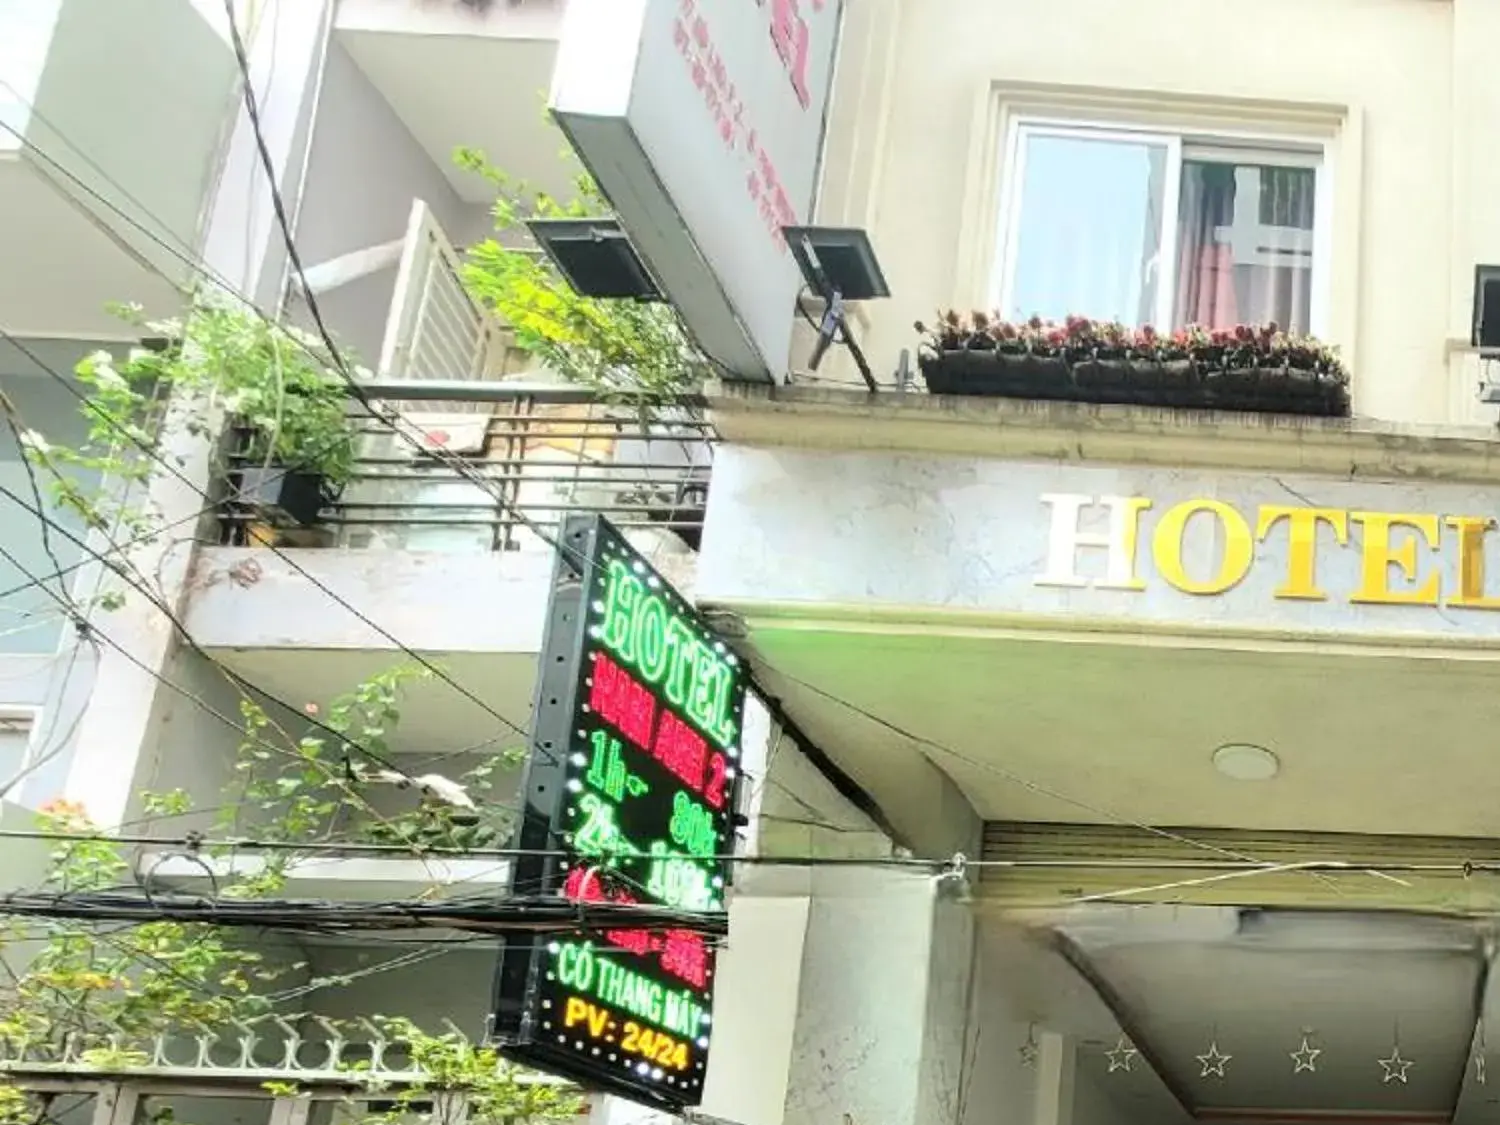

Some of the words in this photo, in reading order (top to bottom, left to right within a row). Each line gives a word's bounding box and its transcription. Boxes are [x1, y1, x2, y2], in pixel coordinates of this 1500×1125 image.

[601, 559, 737, 747] HOTEL
[704, 752, 725, 809] 2
[558, 940, 593, 991] CÓ
[596, 956, 662, 1023] THANG
[663, 990, 703, 1039] MÁY
[564, 996, 616, 1042] PV:
[621, 1021, 688, 1072] 24/24
